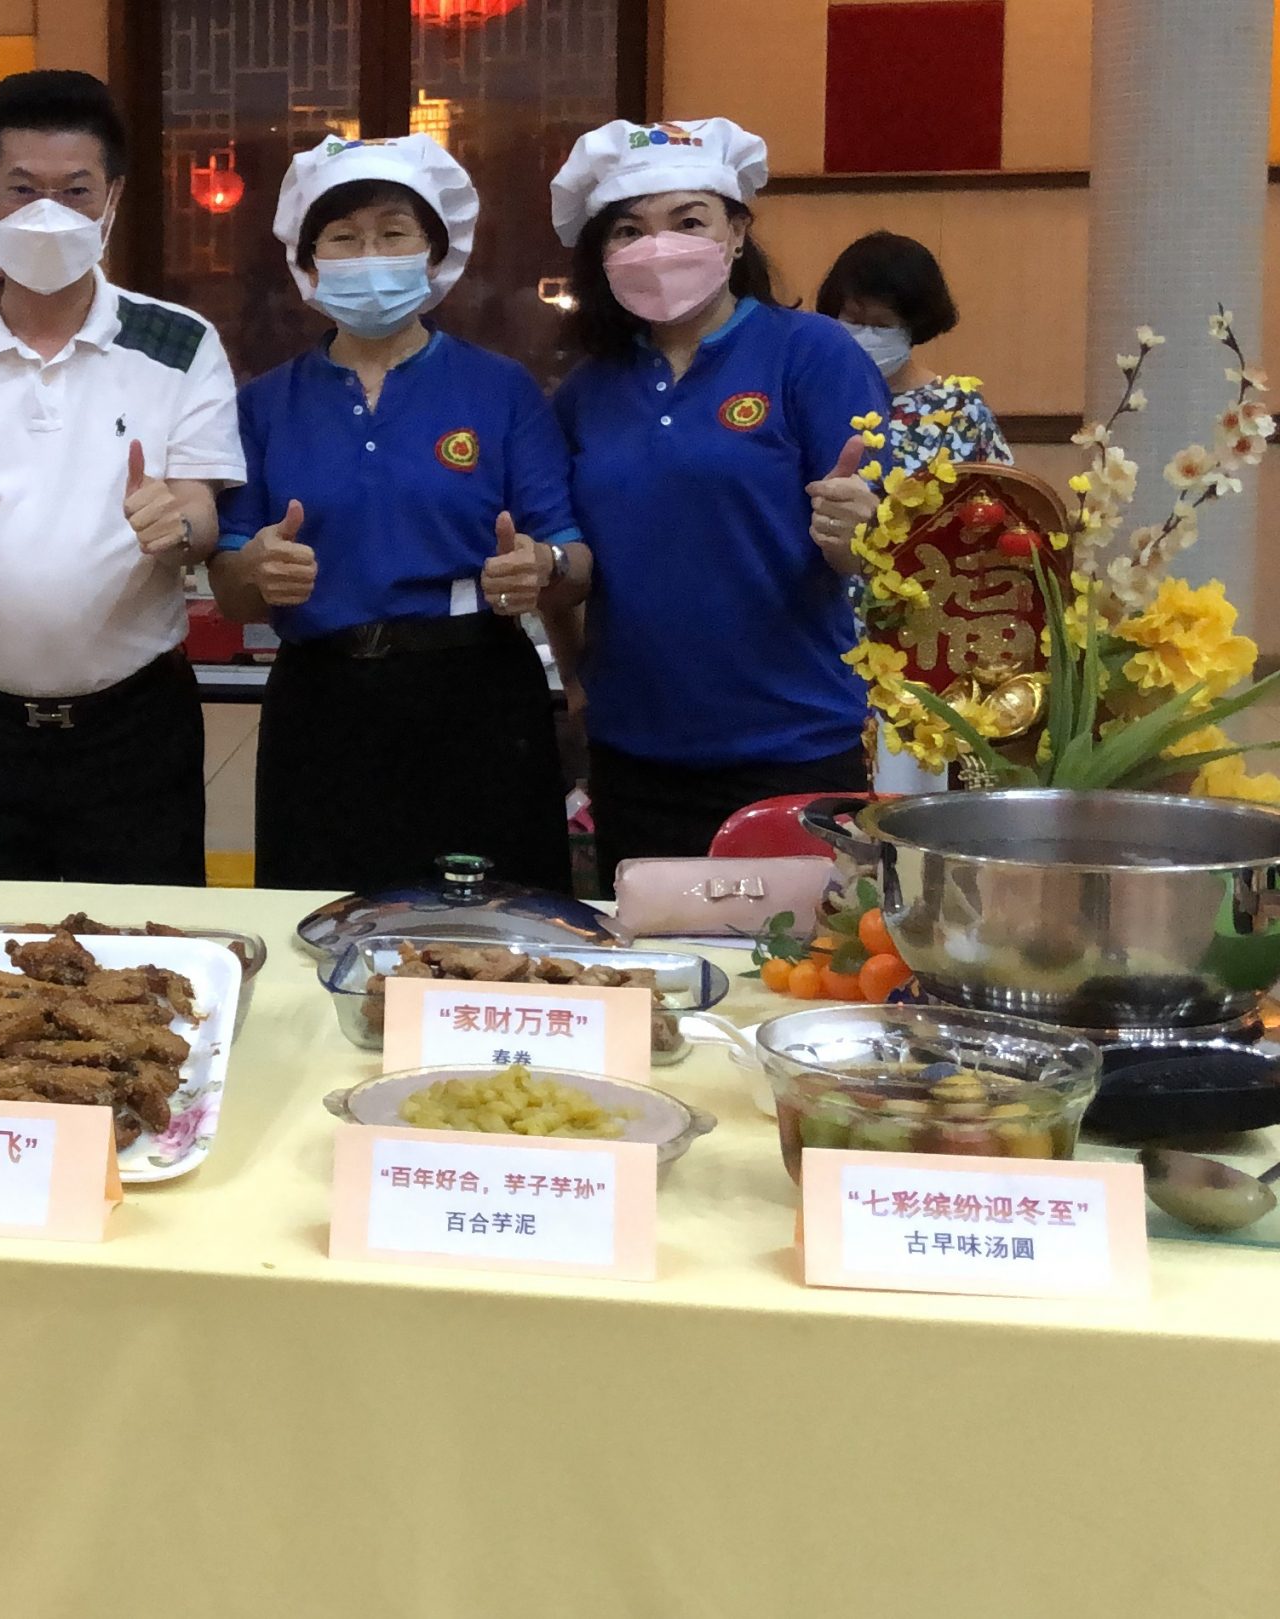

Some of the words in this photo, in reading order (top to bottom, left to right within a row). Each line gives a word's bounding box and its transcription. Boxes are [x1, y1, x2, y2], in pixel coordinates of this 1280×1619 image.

[440, 1004, 588, 1038] “家财万贯”
[445, 1211, 536, 1235] 百合芋泥
[847, 1189, 1089, 1226] “七彩缤纷迎冬至”
[904, 1230, 1035, 1260] 古早味汤圆
